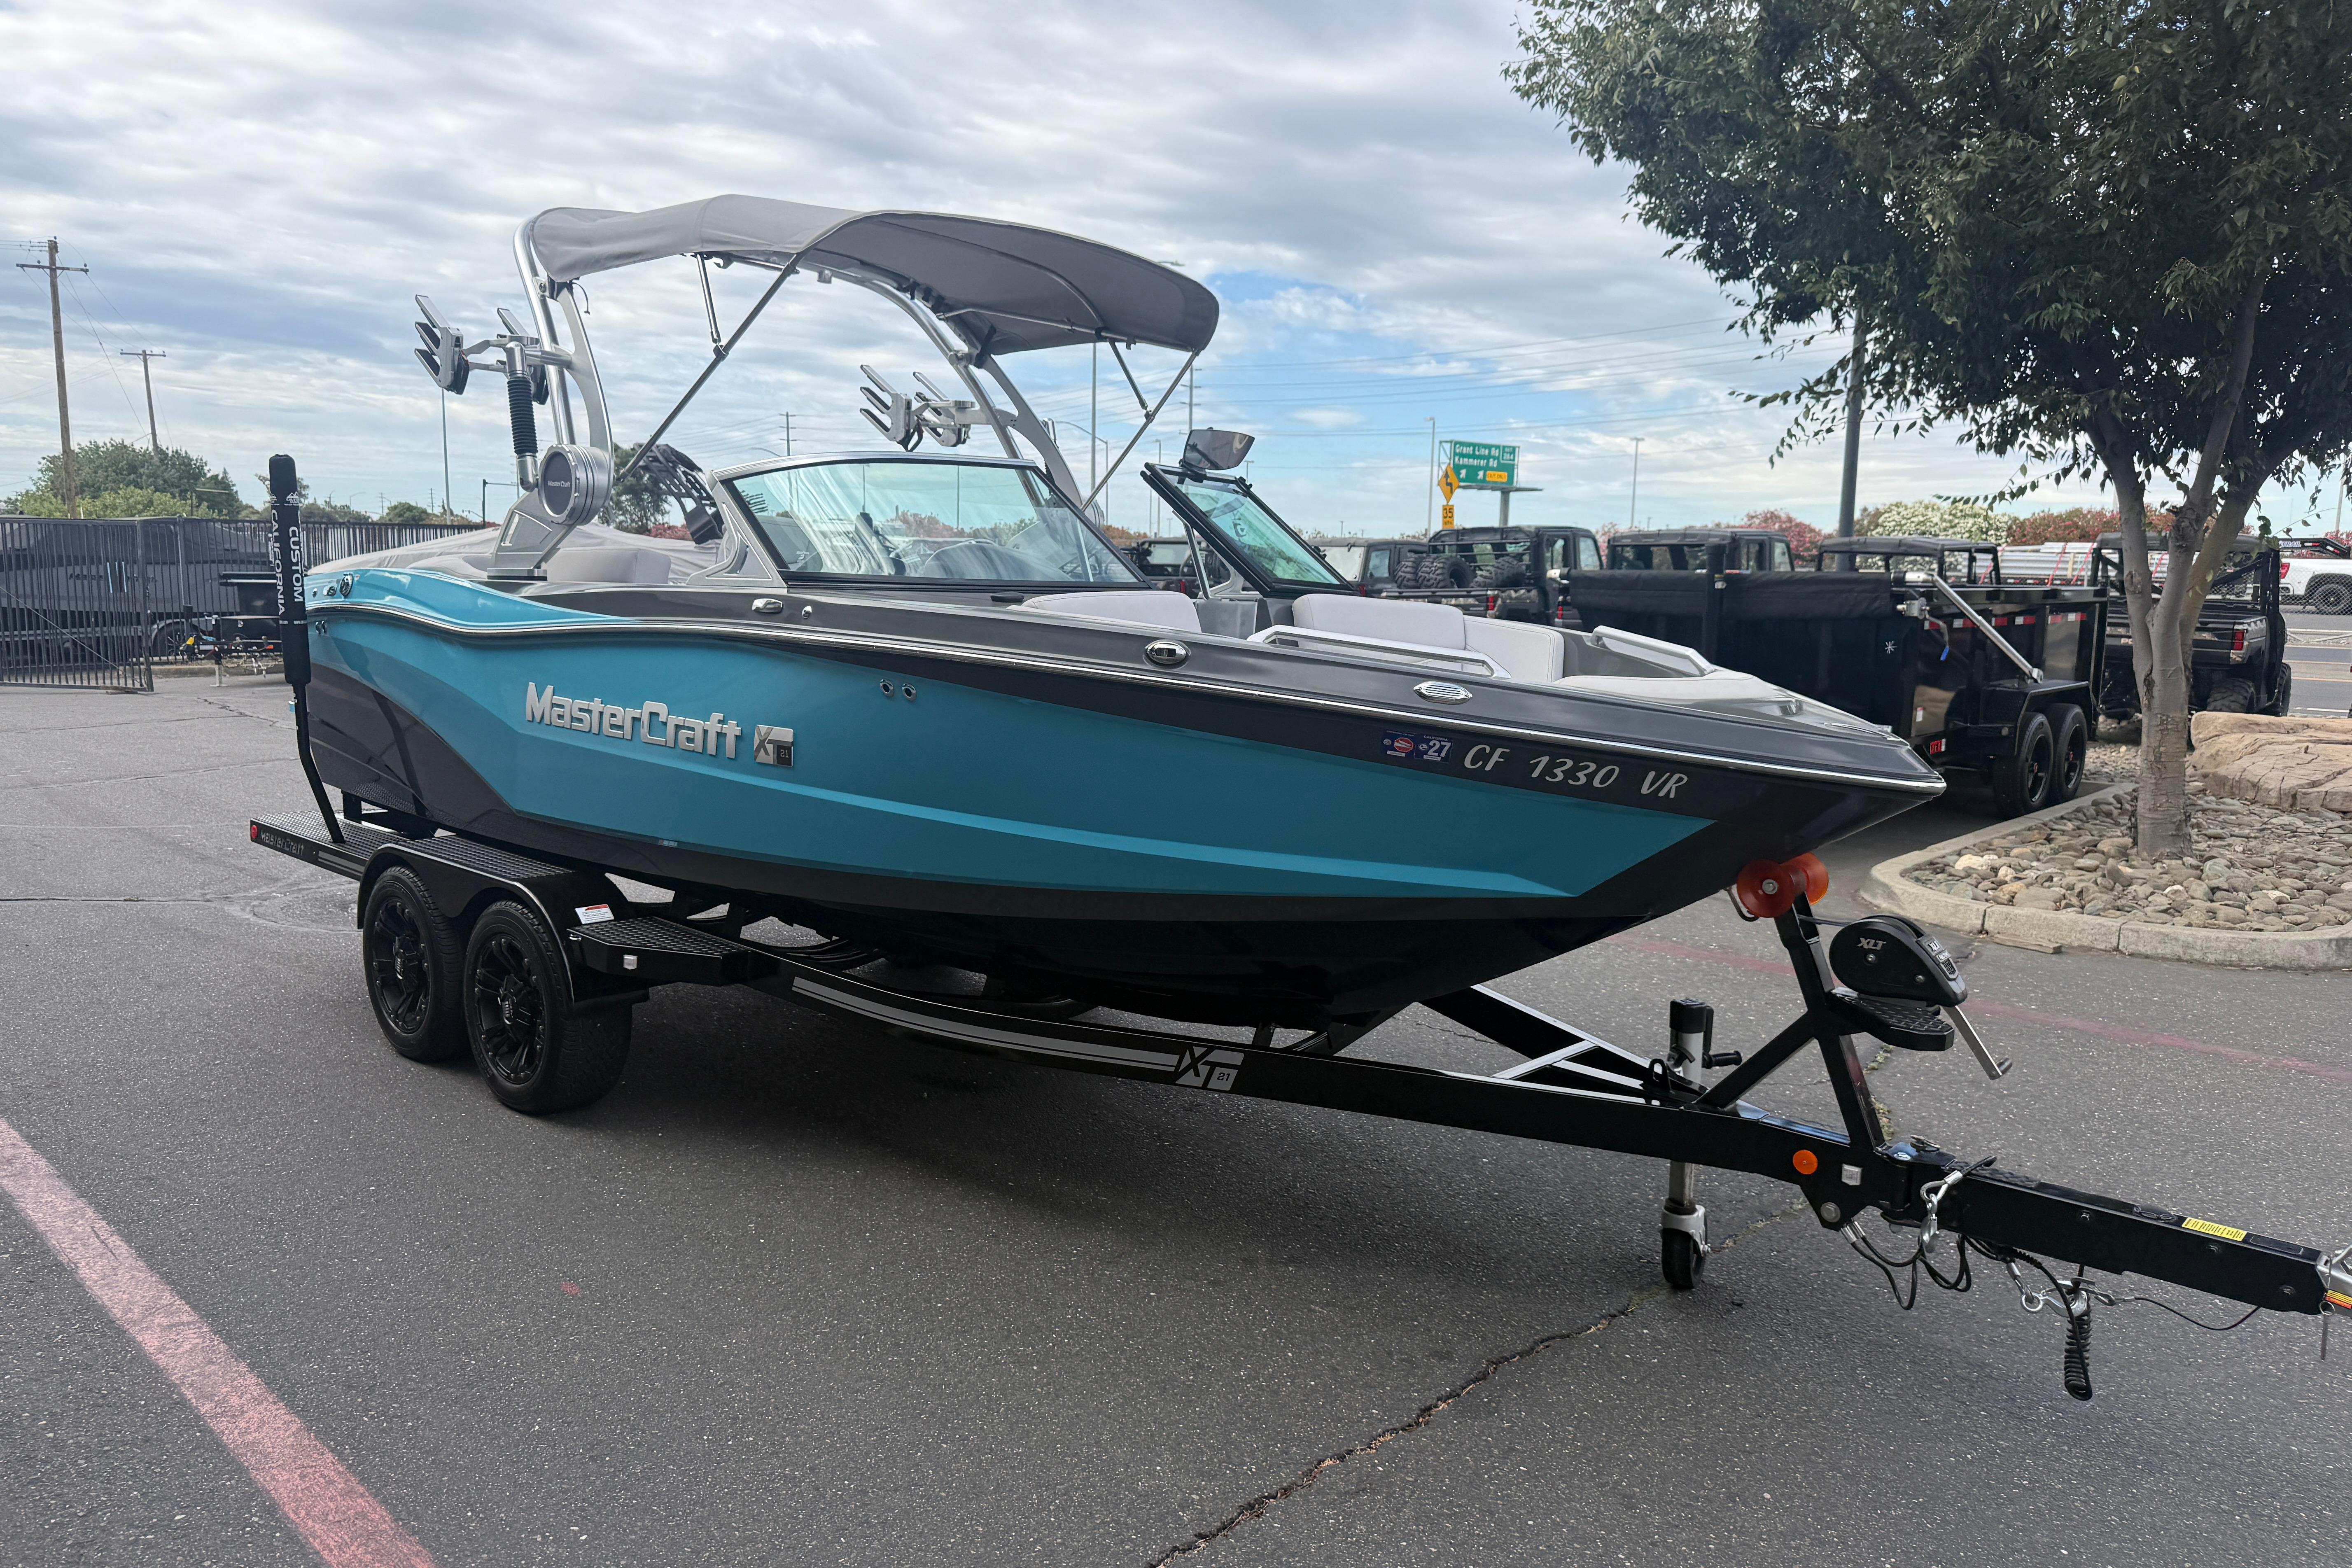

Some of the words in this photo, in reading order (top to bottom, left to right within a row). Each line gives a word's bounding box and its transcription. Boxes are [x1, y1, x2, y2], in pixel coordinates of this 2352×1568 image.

[1456, 444, 1473, 454] Grant
[1475, 446, 1489, 455] Line
[1491, 447, 1499, 457] Rd
[1455, 455, 1486, 467] Kammerer
[1489, 458, 1498, 467] Rd
[1443, 508, 1454, 519] 35
[271, 509, 285, 615] CALIFORNIA
[289, 526, 303, 602] CUSTOM
[526, 682, 742, 758] MasterCraft
[1427, 740, 1451, 757] 27
[1463, 744, 1511, 771] CF
[1529, 756, 1619, 788] 1330
[1640, 771, 1689, 799] VR
[260, 829, 304, 856] MasterCraft
[1857, 937, 1886, 950] XLT
[1217, 1072, 1231, 1082] 21
